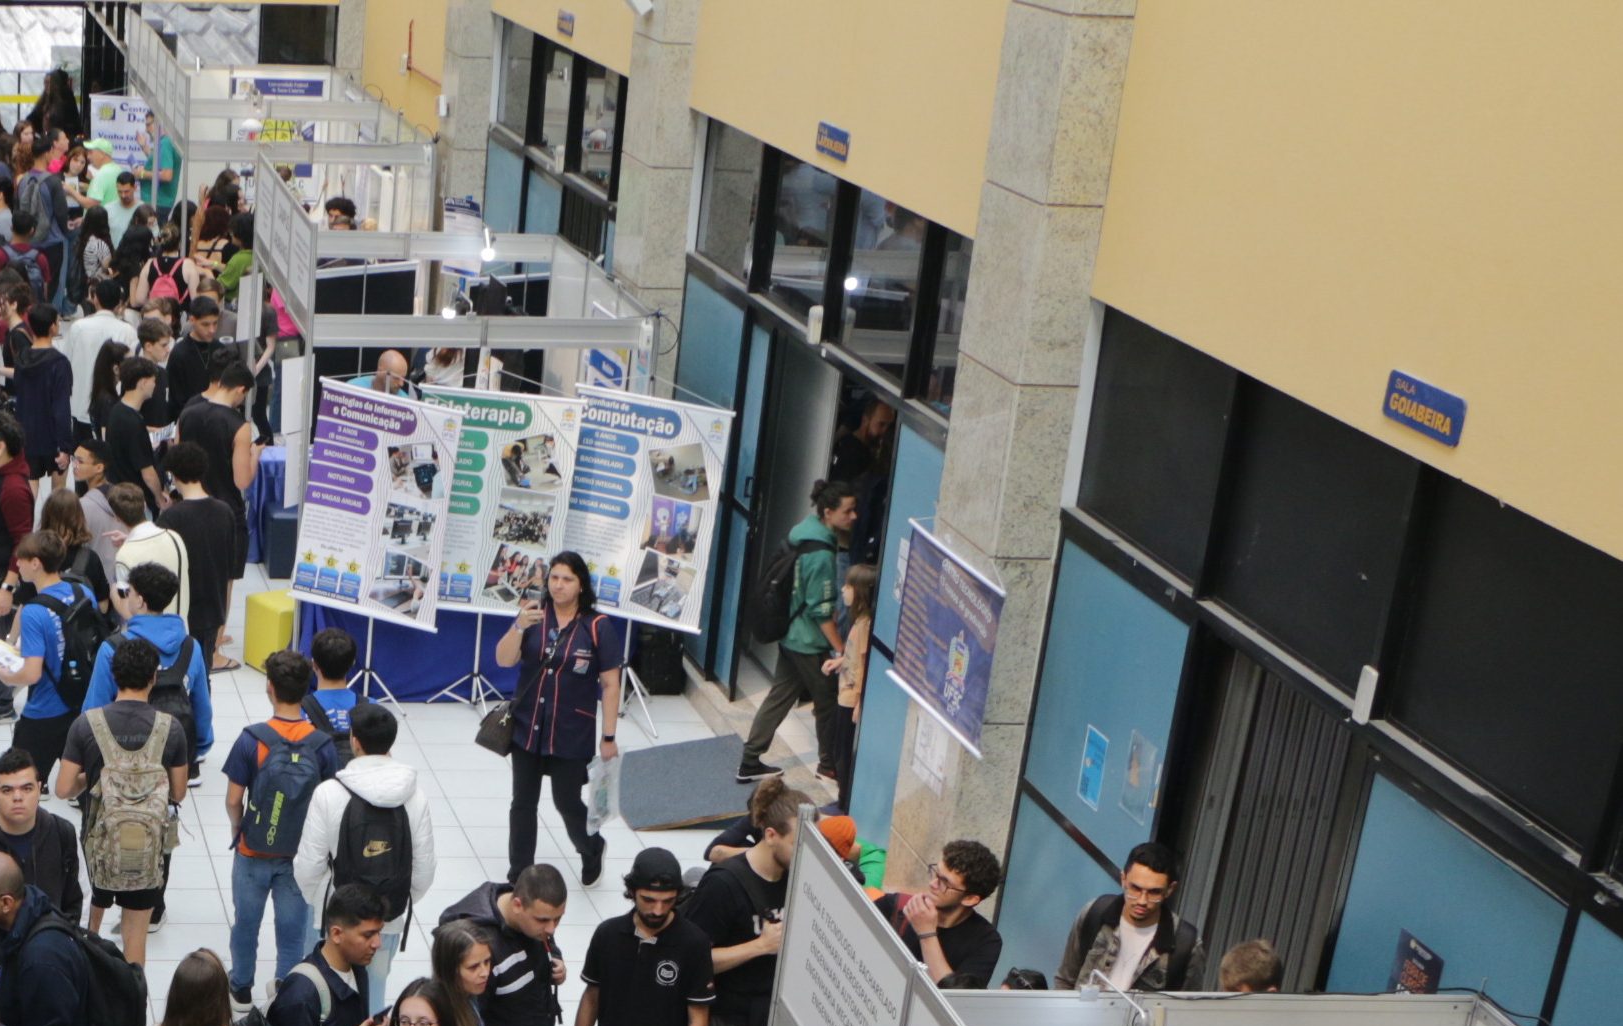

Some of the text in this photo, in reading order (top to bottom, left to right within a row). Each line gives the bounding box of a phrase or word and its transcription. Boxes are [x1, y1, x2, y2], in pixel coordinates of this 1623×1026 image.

[1395, 378, 1416, 395] SALA
[323, 391, 363, 410] Tecnologias
[374, 404, 414, 421] Informação
[341, 406, 400, 431] Comunicação
[581, 404, 674, 435] Computação
[1389, 393, 1451, 436] GOIABEIRA
[805, 958, 836, 1011] ENGENHARIA
[809, 940, 840, 992] ENGENHARIA
[811, 918, 878, 1023] ENGENHARIA AEROESPACIAL
